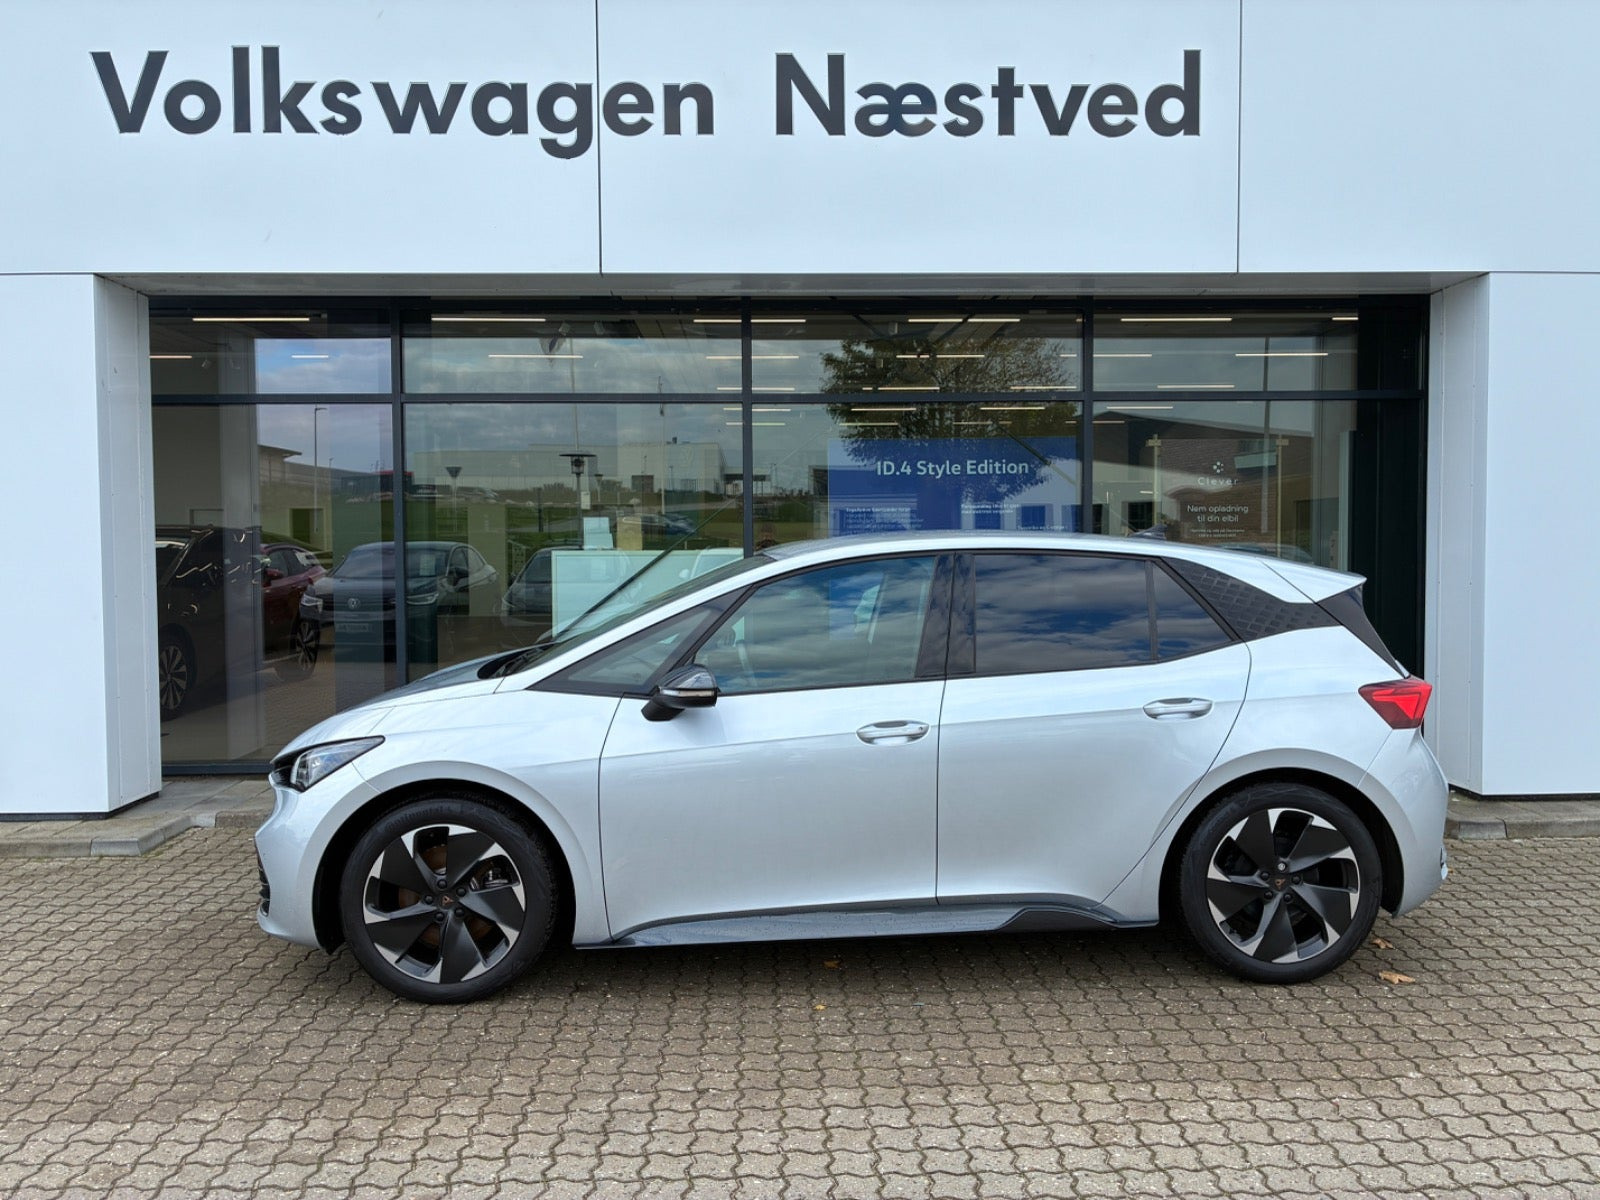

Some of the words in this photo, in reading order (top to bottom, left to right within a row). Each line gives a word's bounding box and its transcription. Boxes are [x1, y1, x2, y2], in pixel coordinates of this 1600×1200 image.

[90, 45, 714, 159] Volkswagen
[775, 49, 1202, 137] Næstved
[876, 460, 912, 476] ID.4
[916, 459, 961, 479] Style
[966, 459, 1029, 475] Edition
[1197, 477, 1238, 486] Clever
[1187, 504, 1207, 513] Nem
[1208, 504, 1249, 514] opladning
[1197, 514, 1205, 522] til
[1207, 514, 1220, 522] din
[1222, 514, 1239, 522] elbil
